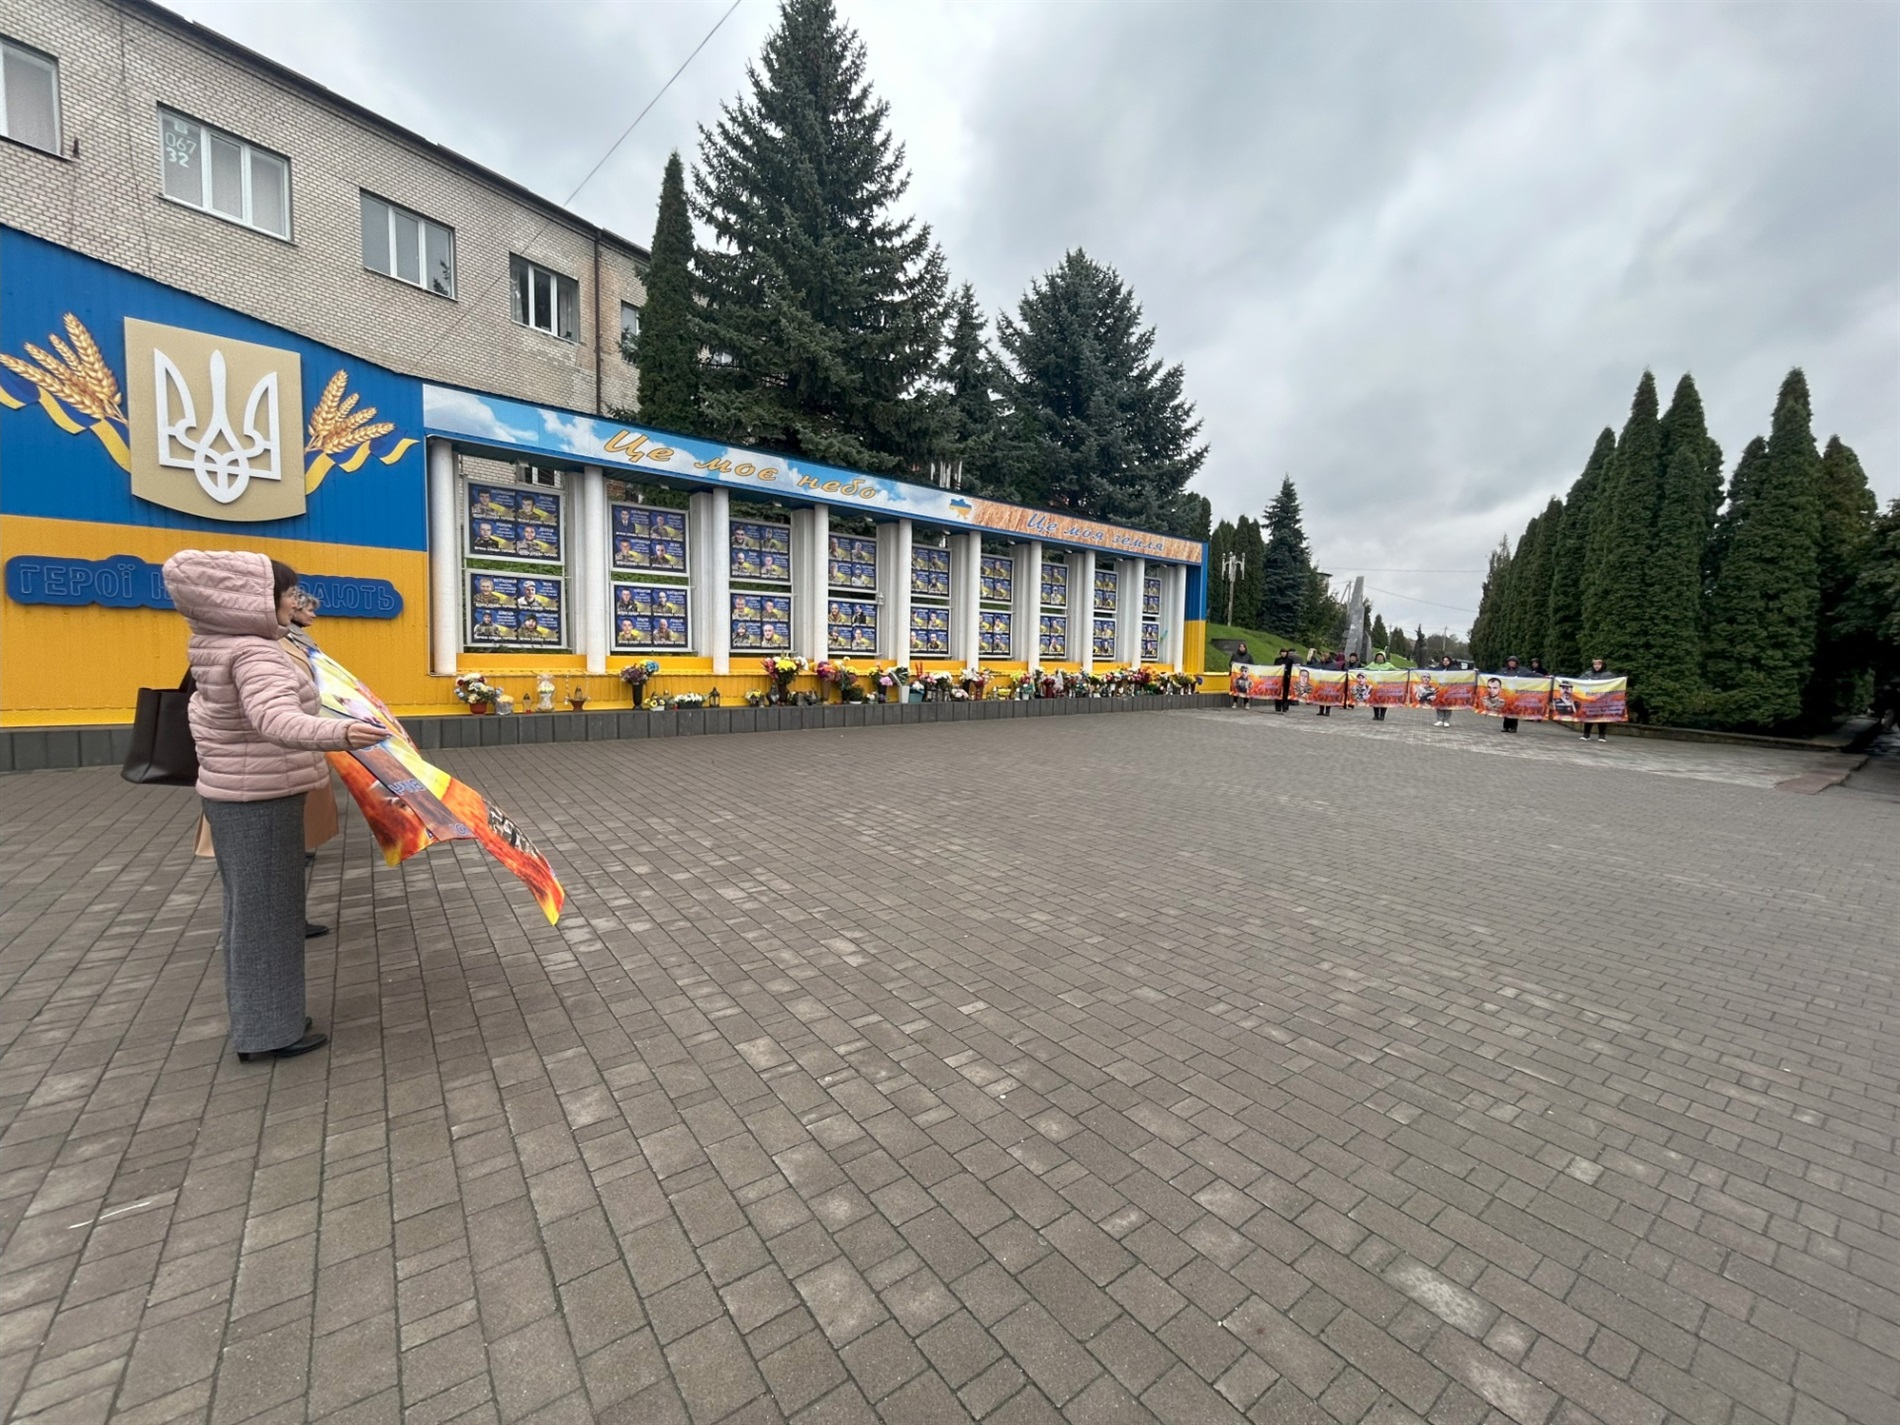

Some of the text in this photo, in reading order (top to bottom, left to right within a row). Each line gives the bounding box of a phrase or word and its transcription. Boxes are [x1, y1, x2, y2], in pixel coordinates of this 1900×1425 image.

[165, 131, 197, 154] 067
[166, 147, 190, 168] 32
[604, 429, 877, 500] Це моє небо
[1027, 512, 1164, 551] Це моя земля
[19, 563, 136, 599] ГЕРОЇ
